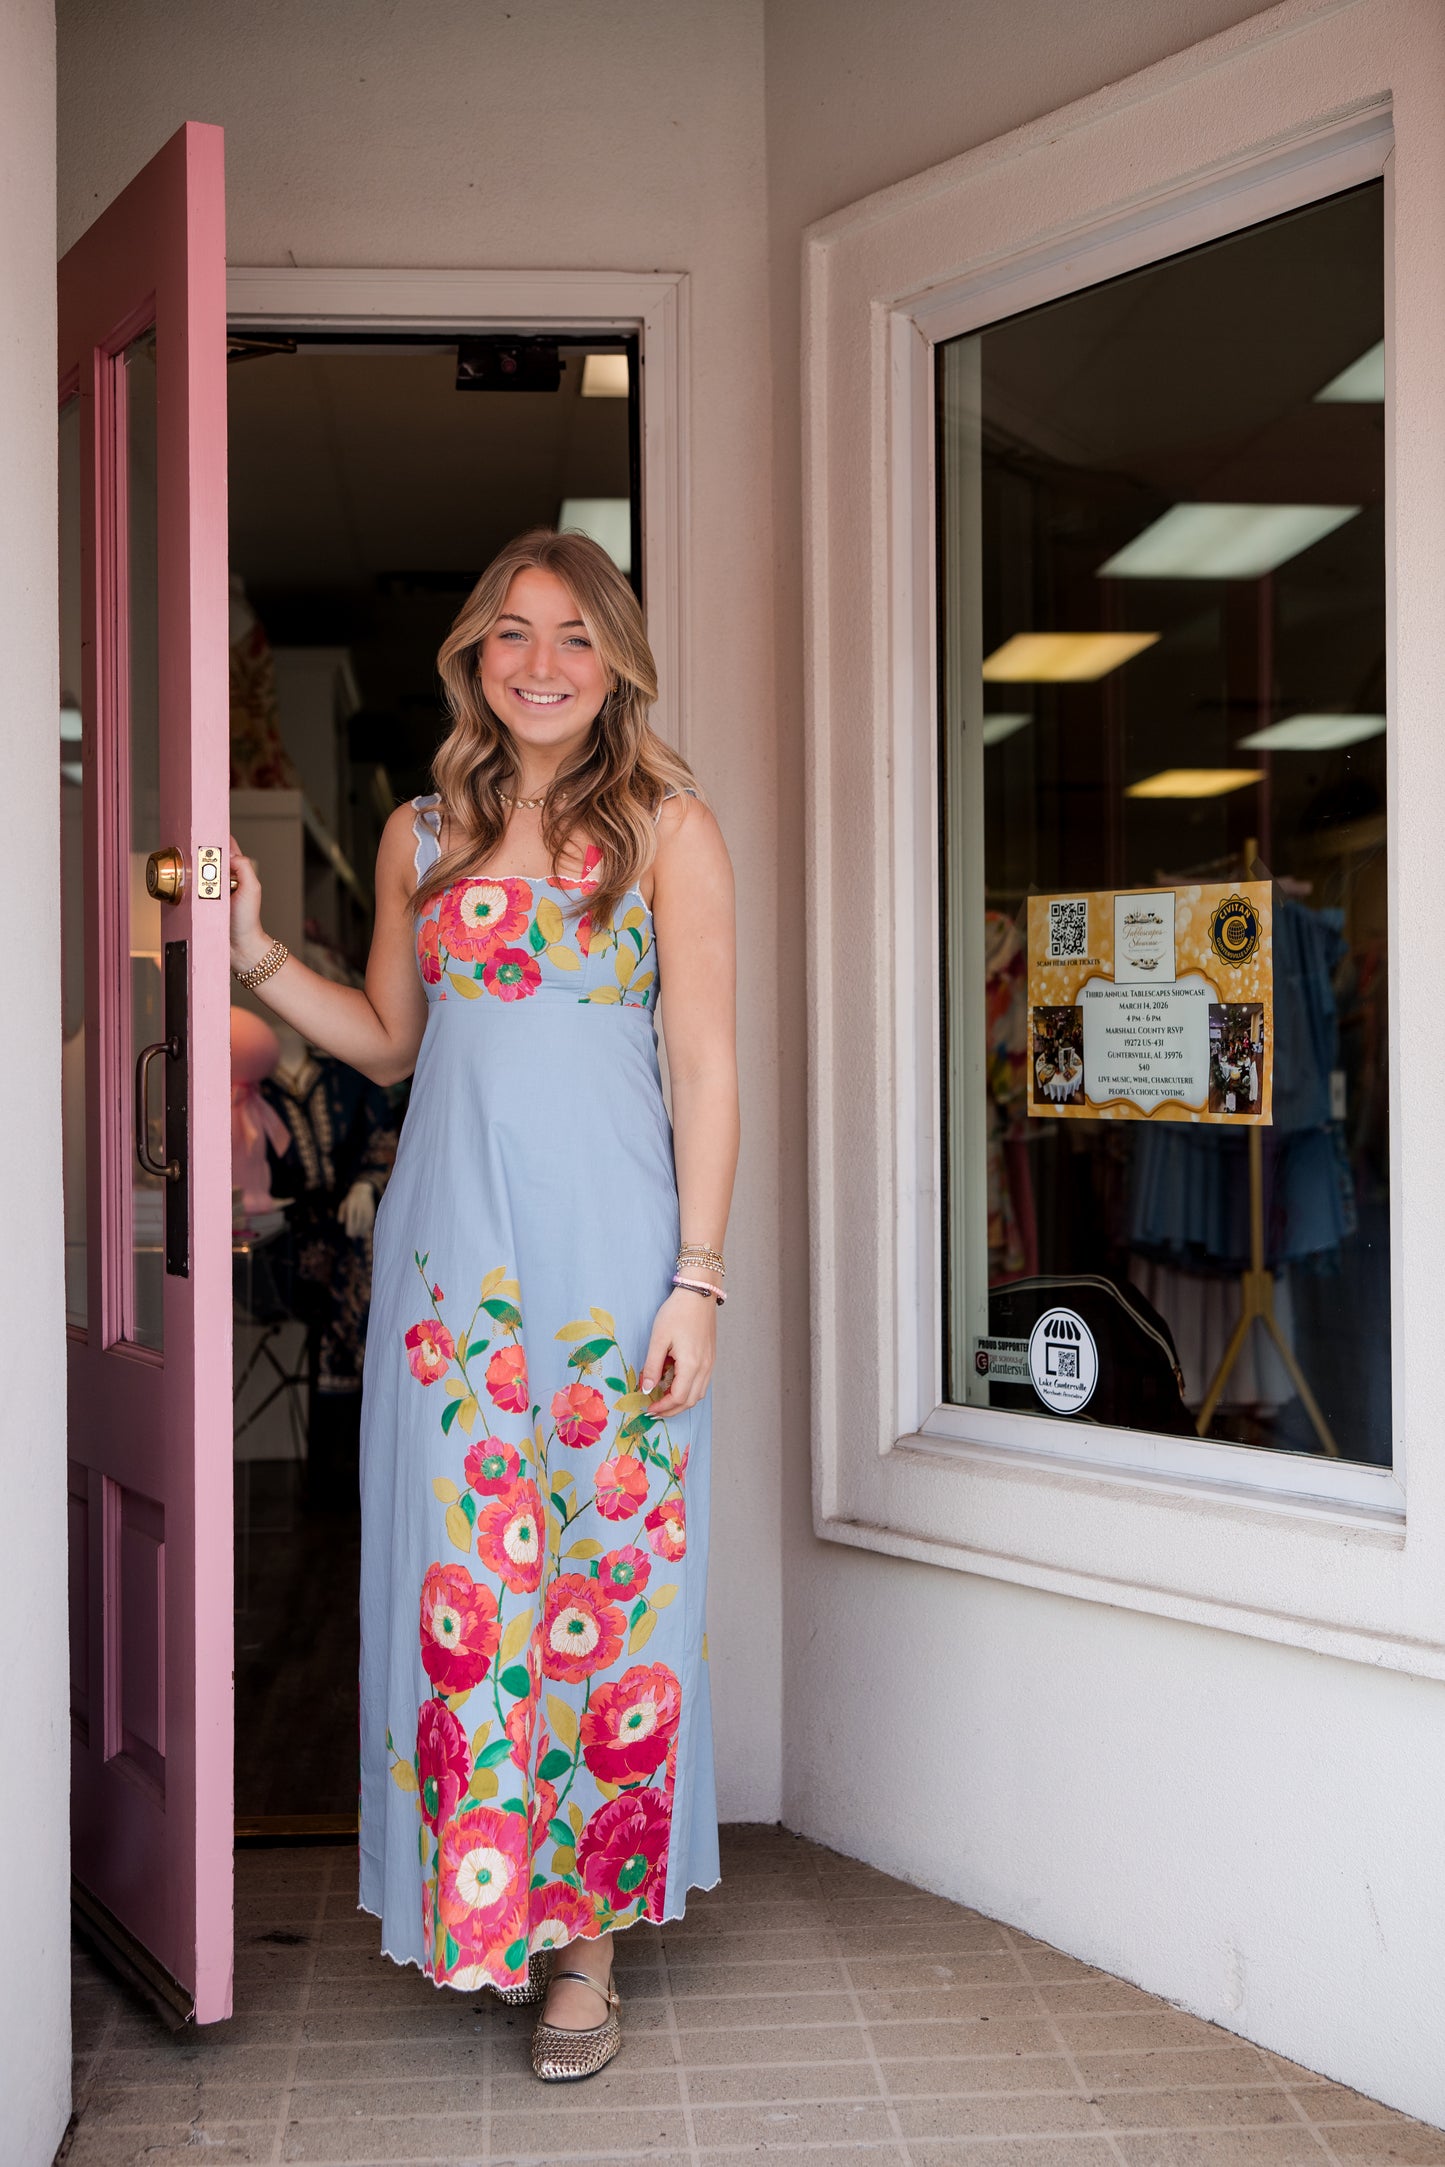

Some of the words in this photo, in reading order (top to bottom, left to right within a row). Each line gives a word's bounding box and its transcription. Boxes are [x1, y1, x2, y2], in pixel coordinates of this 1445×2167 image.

[1219, 903, 1251, 920] CIVITAN
[1079, 958, 1101, 966] TICKETS
[1143, 1002, 1151, 1010] 14,
[1152, 1001, 1169, 1010] 2026
[1126, 1014, 1131, 1022] 4
[1145, 1014, 1151, 1022] 6
[1166, 1026, 1184, 1034] RSVP
[1124, 1038, 1141, 1046] 19272
[1142, 1038, 1164, 1046] US-431
[1153, 1051, 1162, 1059] AL
[1164, 1051, 1183, 1060] 35976
[1138, 1063, 1150, 1071] $40
[978, 1339, 997, 1350] PROUD
[989, 1361, 1031, 1376] Guntersvill
[1038, 1376, 1052, 1387] Lake
[1054, 1379, 1087, 1392] Guntersville
